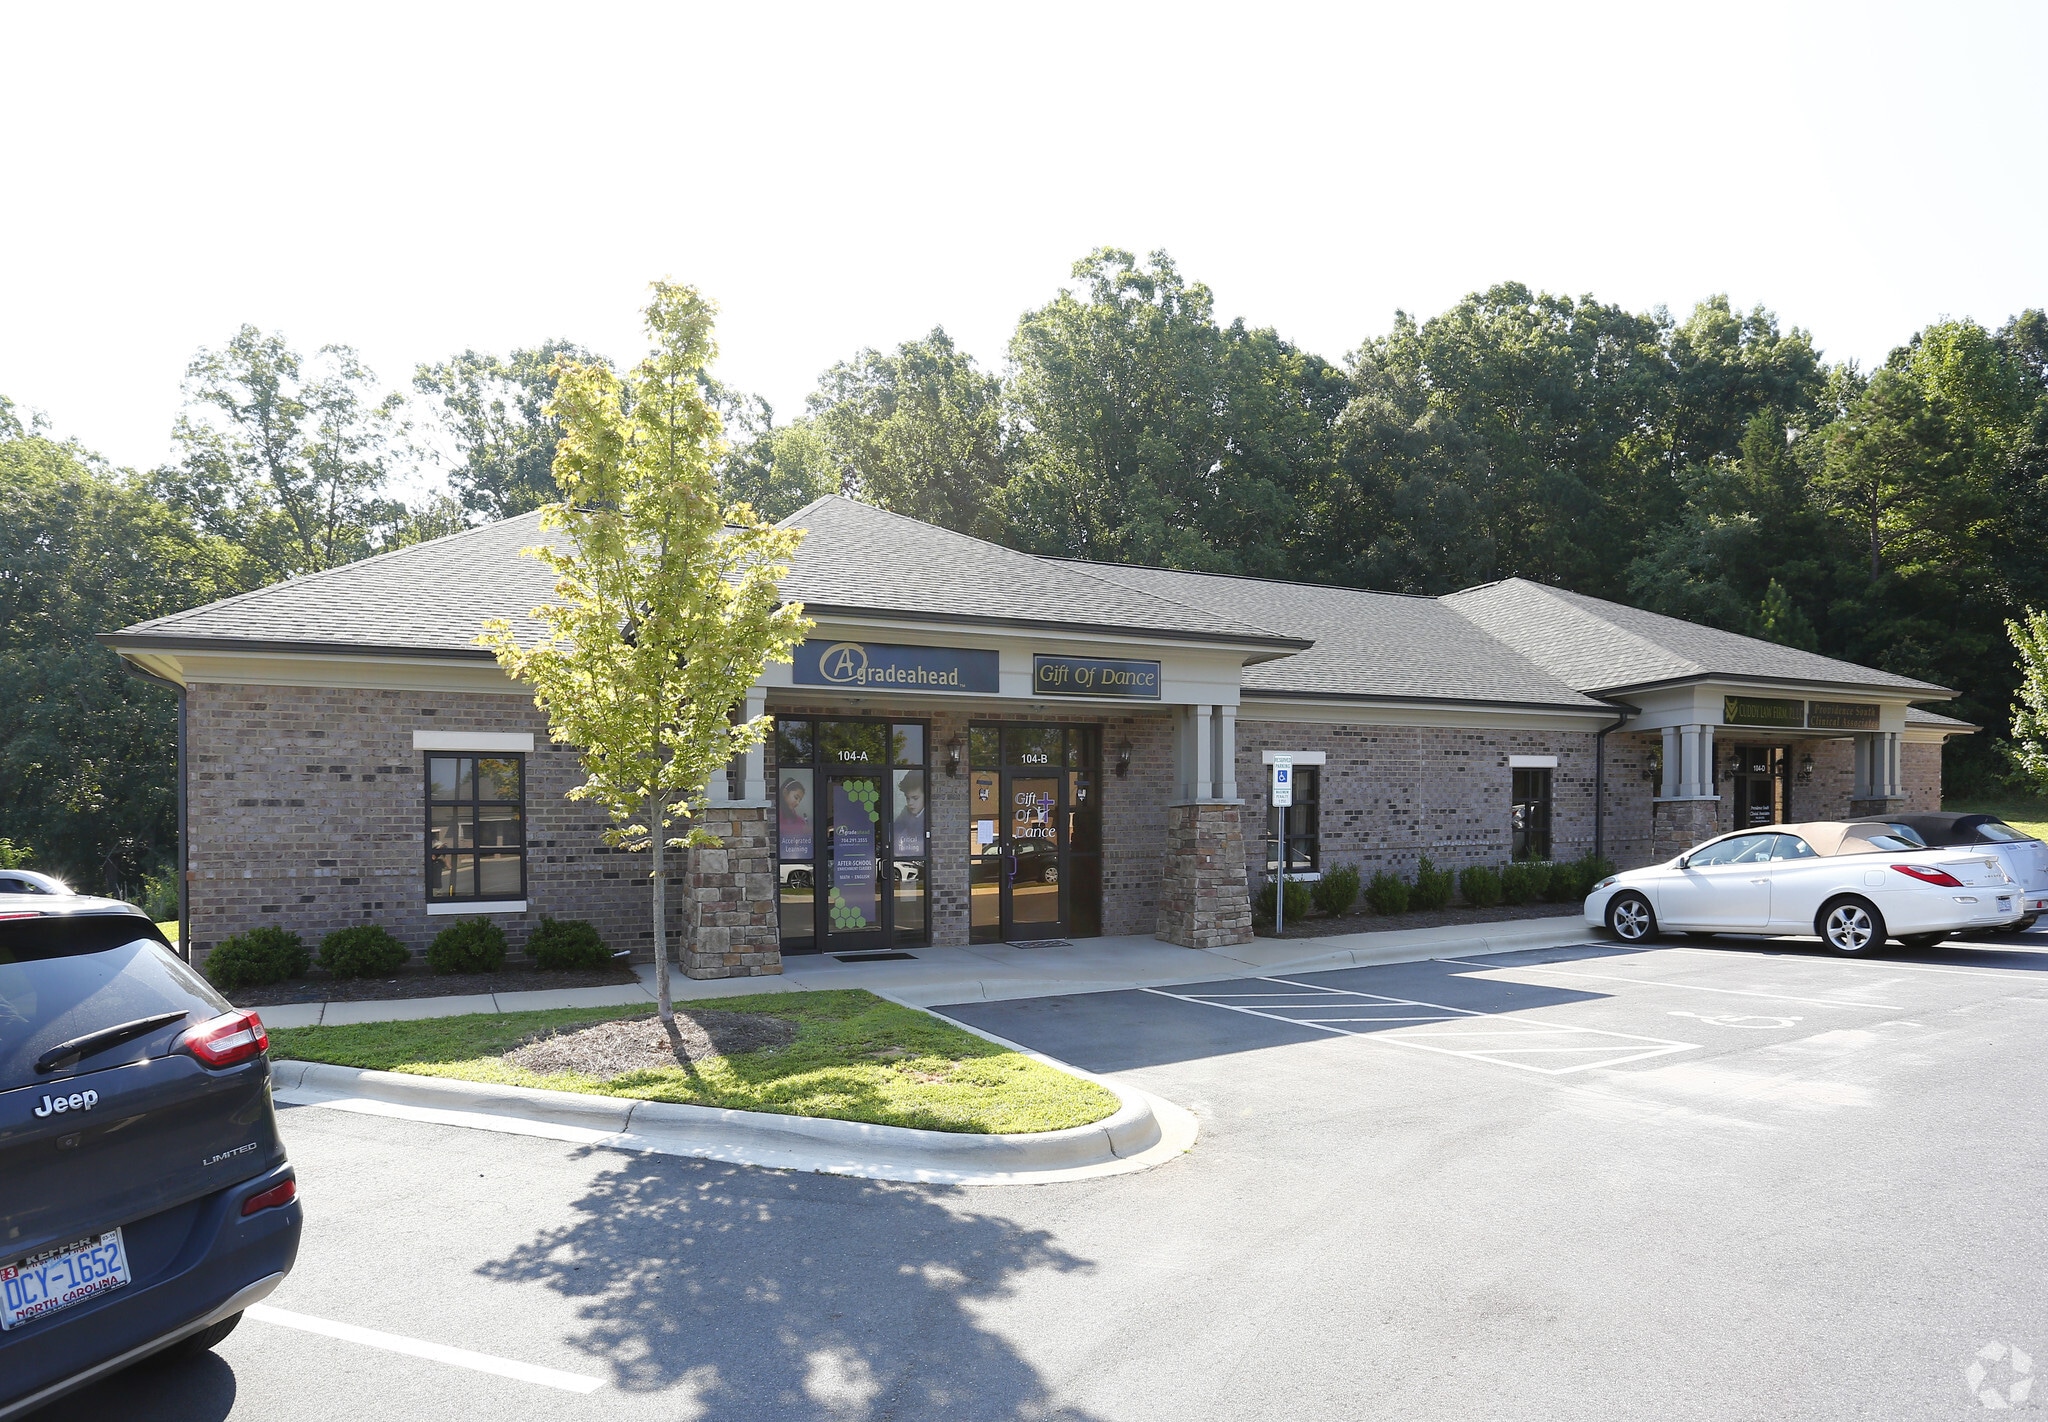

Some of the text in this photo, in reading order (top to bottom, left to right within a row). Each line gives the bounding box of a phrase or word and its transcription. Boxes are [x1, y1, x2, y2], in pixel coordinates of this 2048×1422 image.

[1039, 664, 1155, 688] Gift Of Dance
[1739, 704, 1760, 718] CUDDY
[1760, 705, 1773, 718] LAW
[1814, 703, 1876, 717] Providence South
[1810, 716, 1880, 728] Clinical Associates
[838, 750, 868, 761] 104-A
[1021, 754, 1048, 764] 104-B
[1014, 792, 1037, 807] Gift
[1015, 809, 1032, 824] Of
[1015, 826, 1056, 839] Dance
[781, 836, 812, 845] Accelerated
[785, 845, 808, 854] Learning
[34, 1088, 98, 1118] Jeep
[203, 1142, 257, 1166] LIMITED
[4, 1243, 122, 1311] DCY-1652
[6, 1267, 16, 1279] 3
[16, 1275, 119, 1320] NORTH CAROLINA
